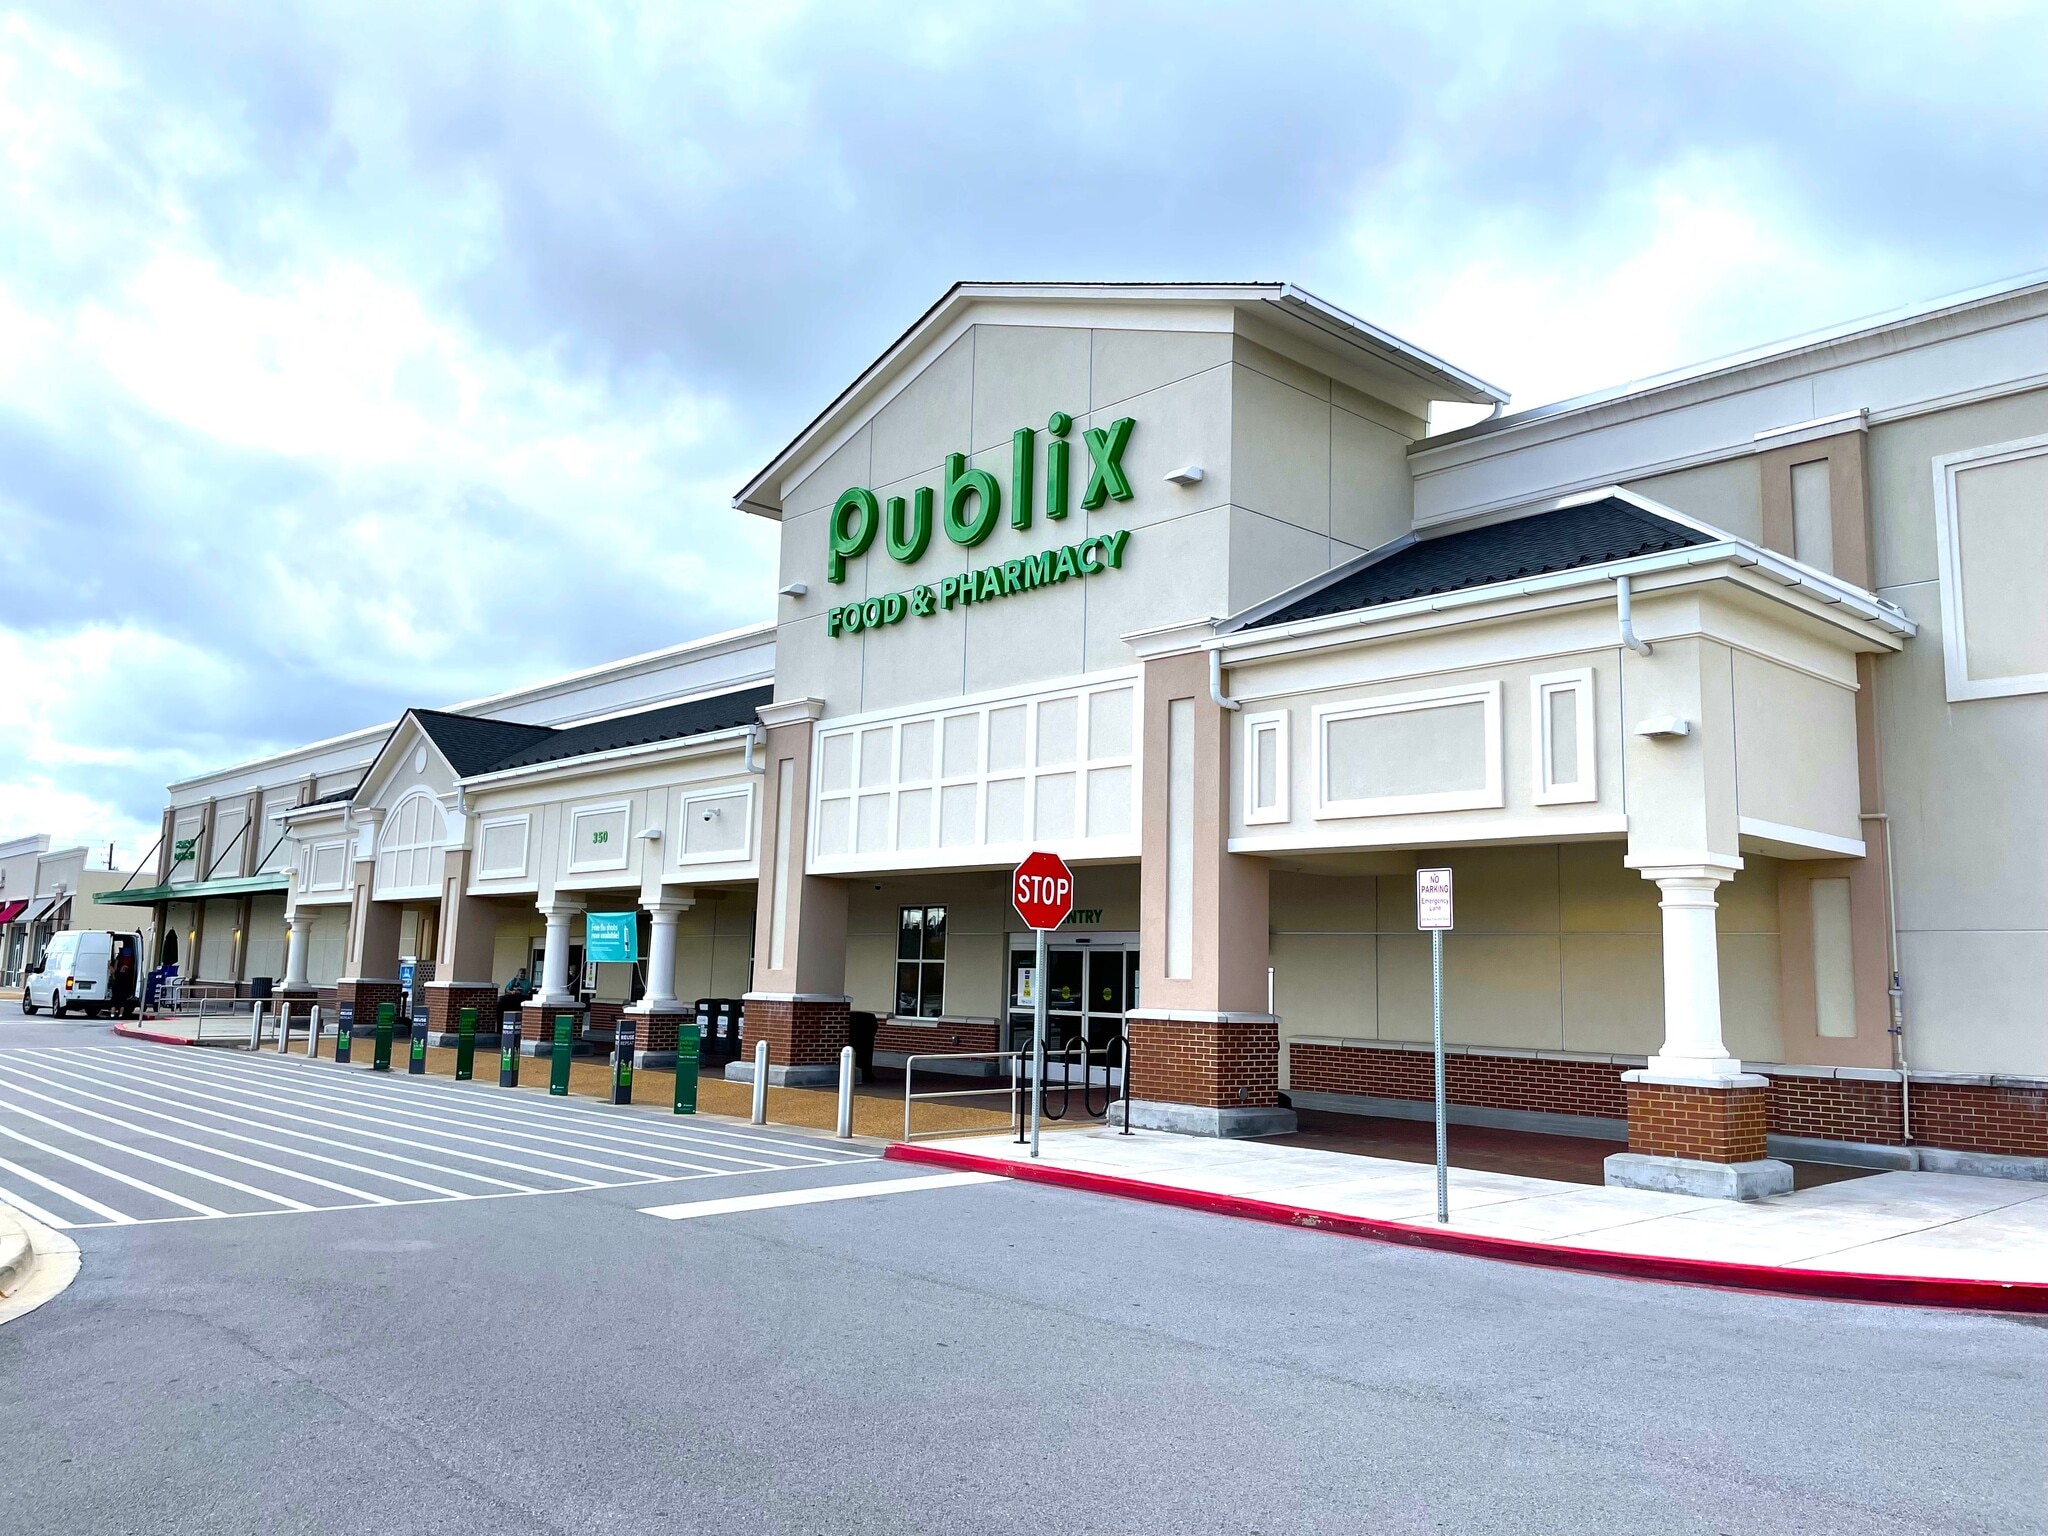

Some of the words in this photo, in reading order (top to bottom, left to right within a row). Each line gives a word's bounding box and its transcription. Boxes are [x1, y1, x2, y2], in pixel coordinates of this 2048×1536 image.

[827, 593, 907, 637] FOOD
[911, 585, 936, 617] &
[941, 530, 1130, 610] PHARMACY
[592, 831, 608, 844] 350
[1430, 875, 1440, 884] NO
[1017, 874, 1069, 906] STOP
[1421, 885, 1449, 893] PARKING
[1063, 909, 1103, 924] NTRY
